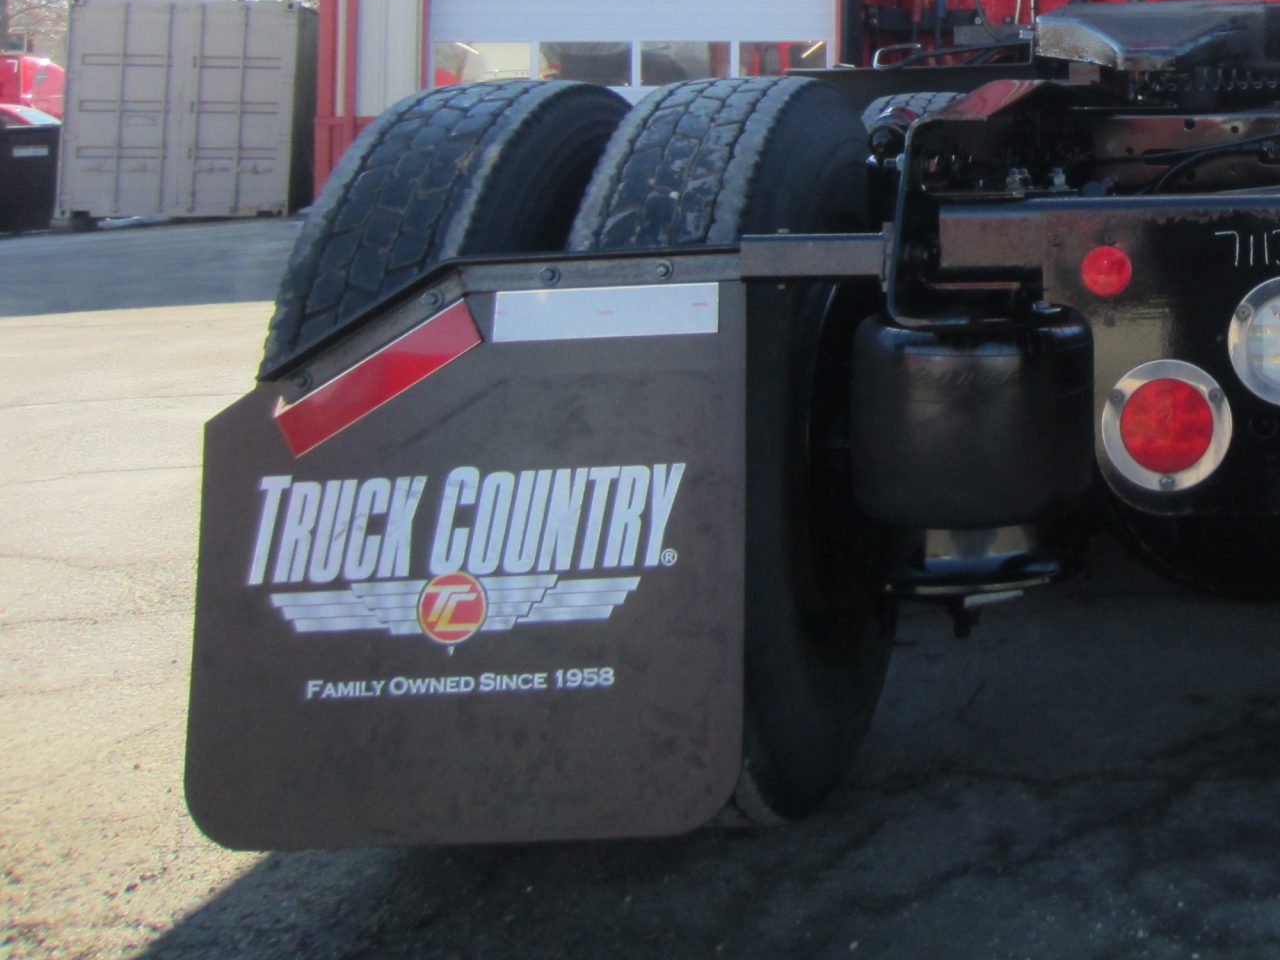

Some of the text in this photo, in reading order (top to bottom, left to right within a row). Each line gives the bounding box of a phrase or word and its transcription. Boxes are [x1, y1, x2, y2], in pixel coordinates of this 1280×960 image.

[247, 475, 428, 586] TRUCK
[306, 667, 615, 699] FAMILY OWNED SINCE 1958
